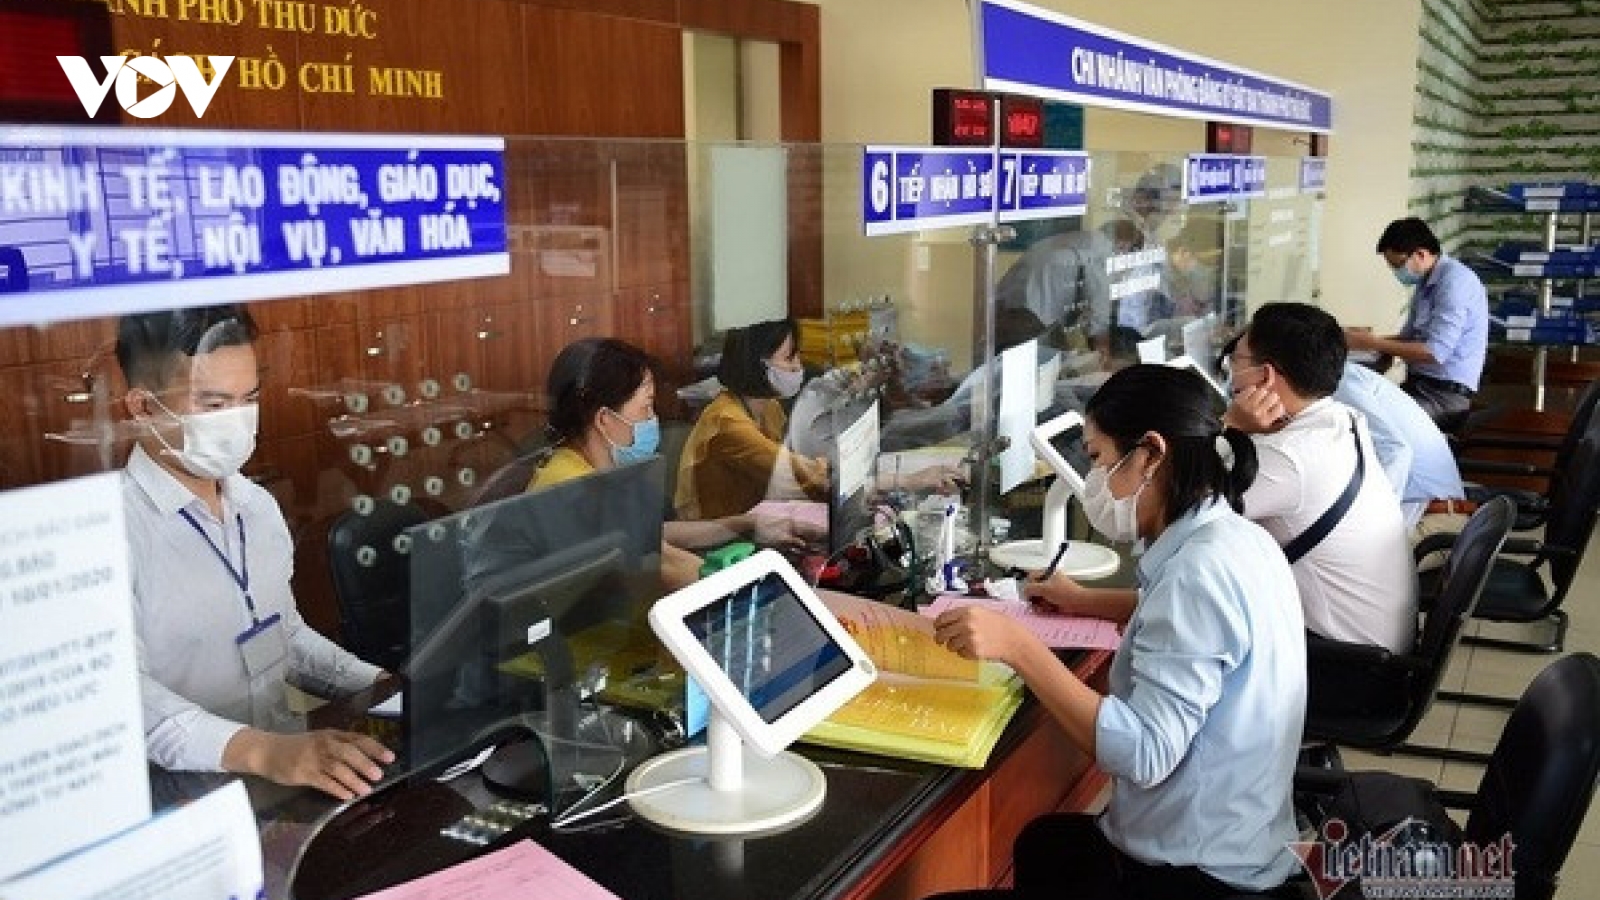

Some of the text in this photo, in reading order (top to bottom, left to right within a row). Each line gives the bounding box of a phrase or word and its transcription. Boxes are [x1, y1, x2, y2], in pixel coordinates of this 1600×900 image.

[323, 3, 377, 40] ĐỨC
[237, 45, 286, 91] HỒ
[300, 52, 355, 93] CHÍ
[368, 66, 443, 98] MINH
[1071, 46, 1097, 85] CHI
[2, 163, 98, 213] KINH
[200, 166, 265, 203] LAO
[278, 152, 369, 215] ĐỘNG,
[377, 148, 439, 203] GIÁO
[445, 160, 500, 209] DỤC,
[871, 159, 889, 213] 6
[1003, 159, 1016, 205] 7
[69, 230, 99, 280] Y
[203, 211, 262, 274] NỘI
[350, 208, 406, 257] VĂN
[418, 201, 473, 251] HÓA
